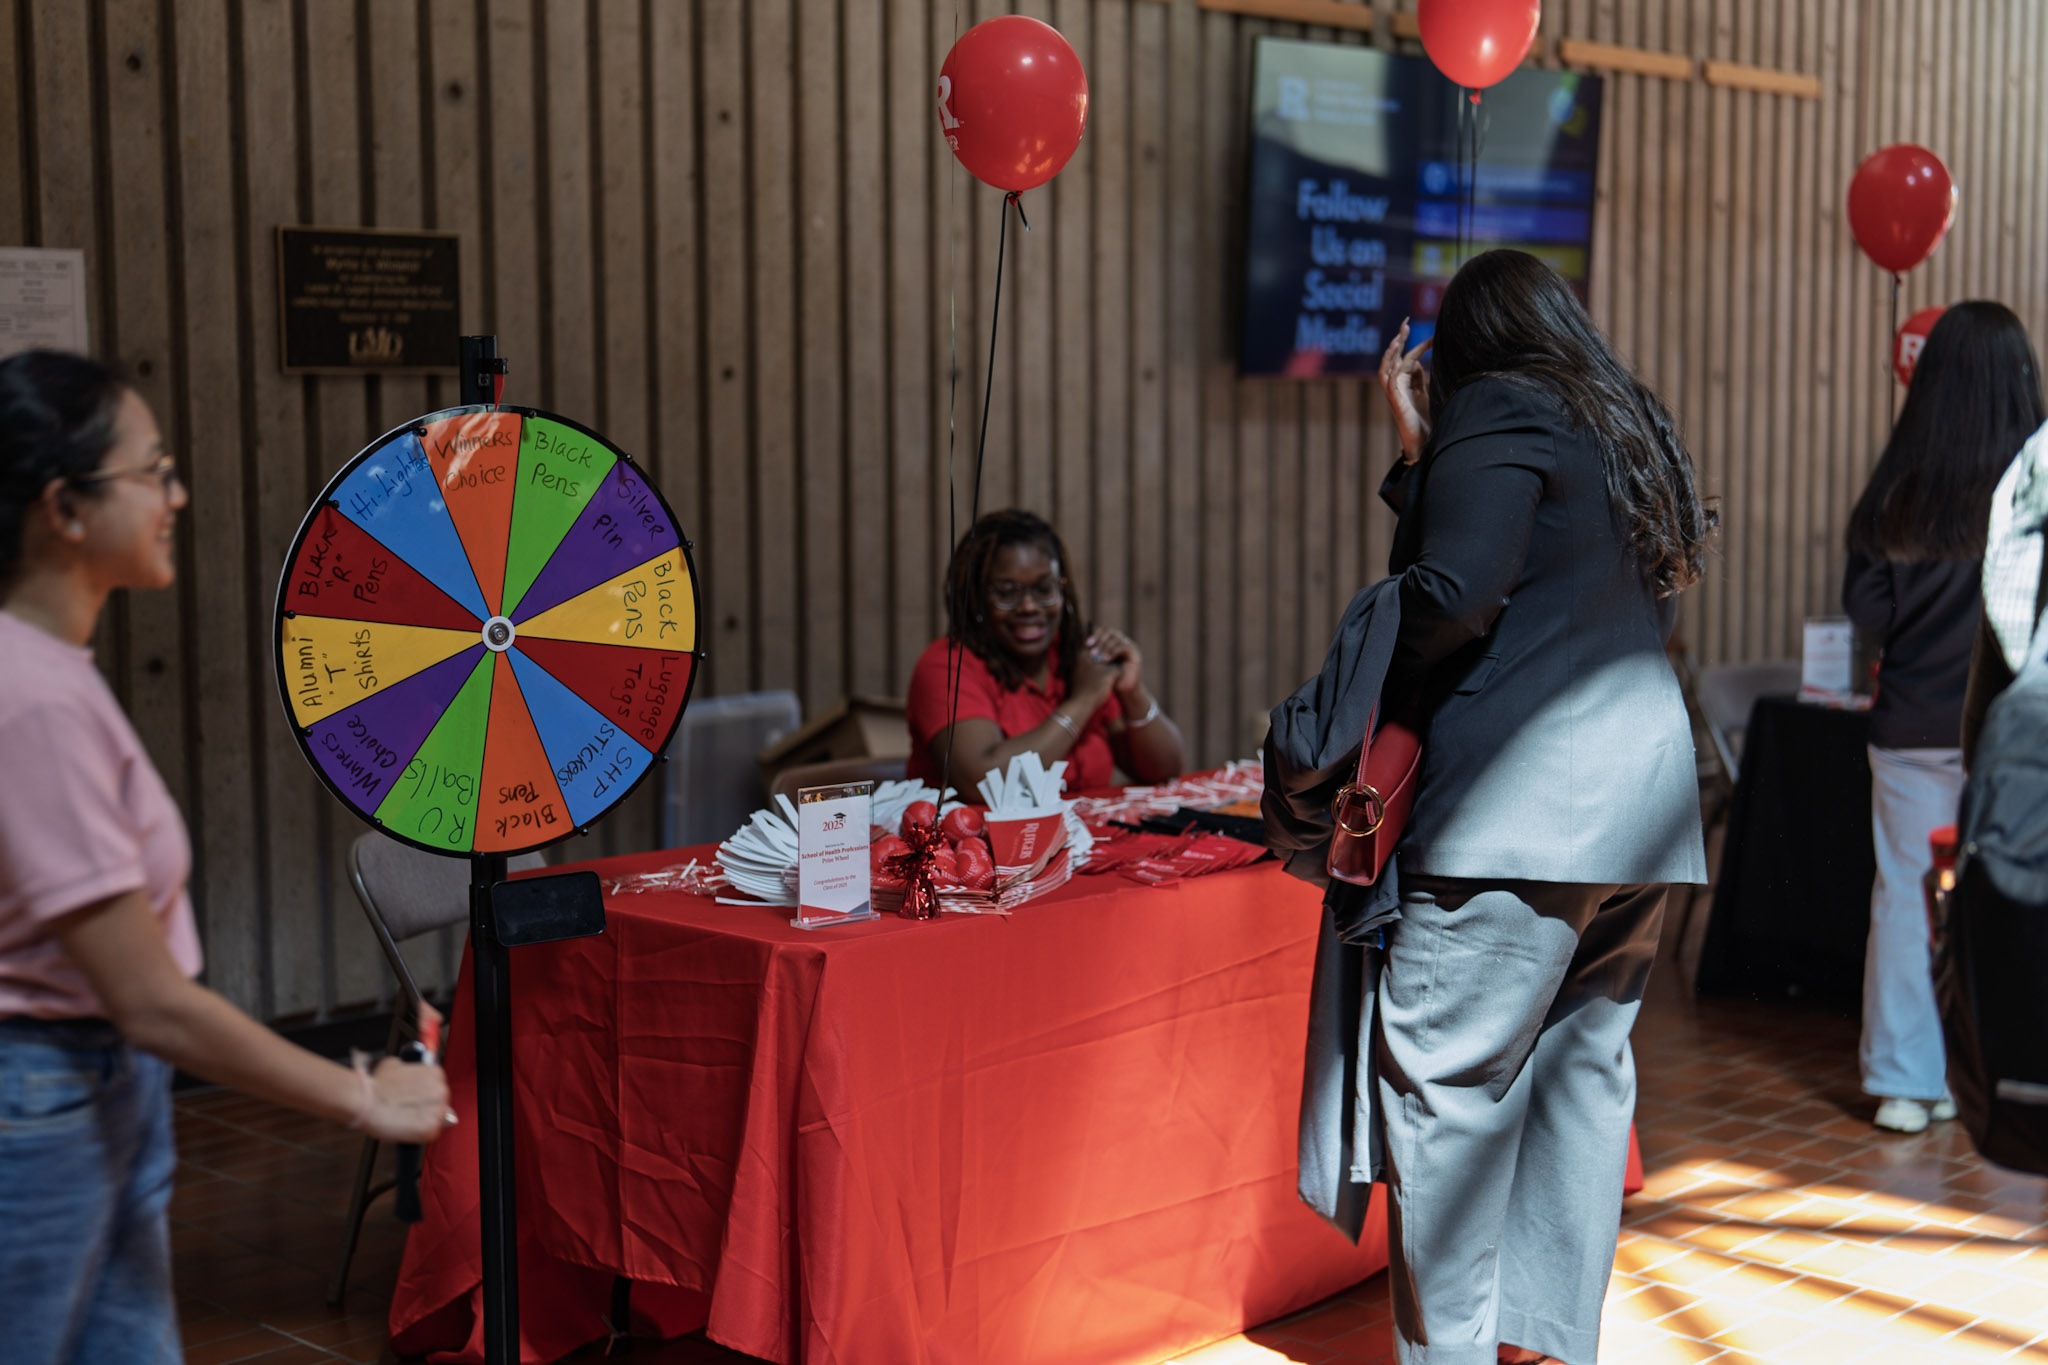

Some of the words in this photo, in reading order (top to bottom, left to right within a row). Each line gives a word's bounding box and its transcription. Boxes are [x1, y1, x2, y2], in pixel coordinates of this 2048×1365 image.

[1297, 178, 1389, 222] Follow
[1311, 224, 1346, 266] Us
[1349, 237, 1386, 267] on
[1302, 270, 1385, 311] Social
[1295, 313, 1382, 355] Media
[535, 431, 593, 468] Black
[445, 464, 505, 491] Choice
[531, 463, 581, 497] Pens
[299, 528, 338, 597] BLACK
[353, 557, 388, 605] Pens
[622, 580, 647, 639] Pens
[654, 561, 678, 639] Black
[291, 636, 323, 707] Alumni
[610, 663, 643, 718] Tags
[639, 656, 680, 740] Luggage
[321, 732, 382, 797] Winners
[347, 715, 397, 769] Choice
[404, 758, 475, 805] Balls
[499, 781, 540, 804] Pens
[593, 746, 632, 799] SHP
[495, 804, 557, 837] Black
[823, 819, 844, 832] 2025
[802, 851, 818, 860] School
[825, 848, 841, 856] Health
